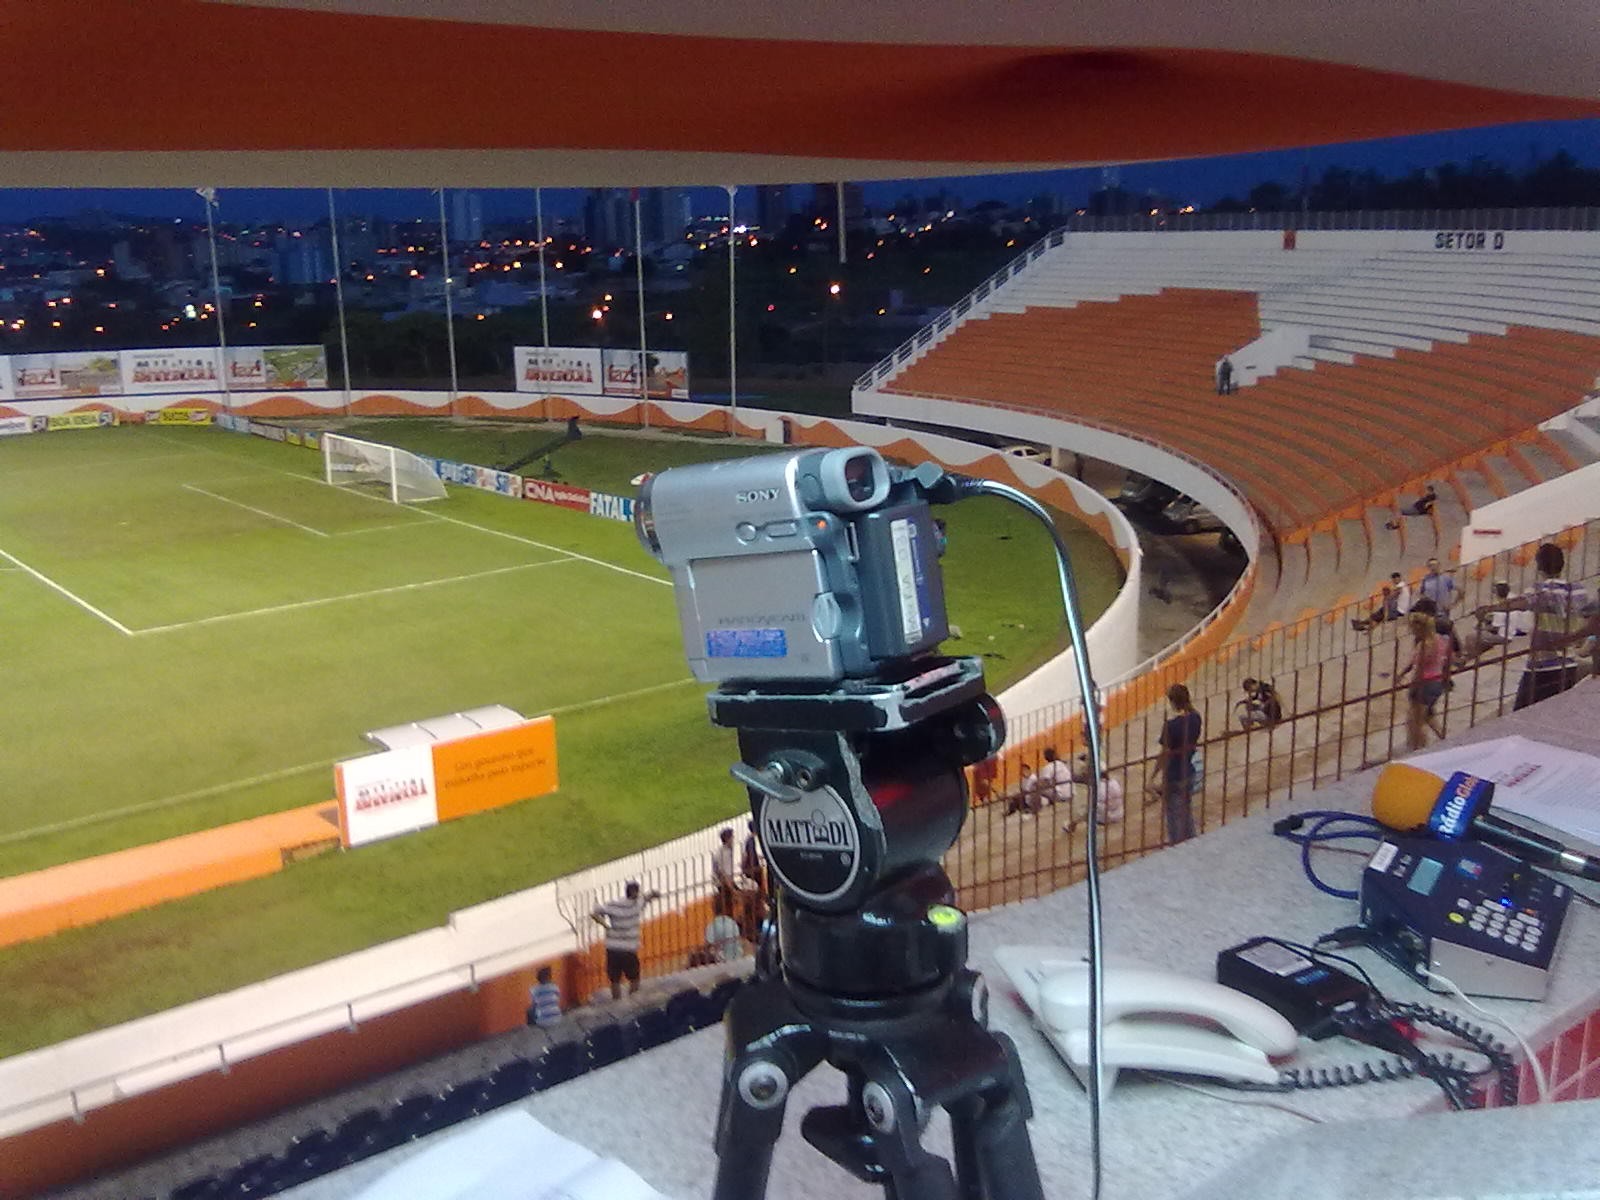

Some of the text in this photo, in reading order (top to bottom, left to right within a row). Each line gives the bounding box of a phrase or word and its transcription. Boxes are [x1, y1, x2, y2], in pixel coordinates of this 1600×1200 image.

[1434, 231, 1504, 250] SETOR D
[525, 481, 555, 502] CNA
[736, 488, 780, 503] SONY
[590, 491, 627, 522] FATAL
